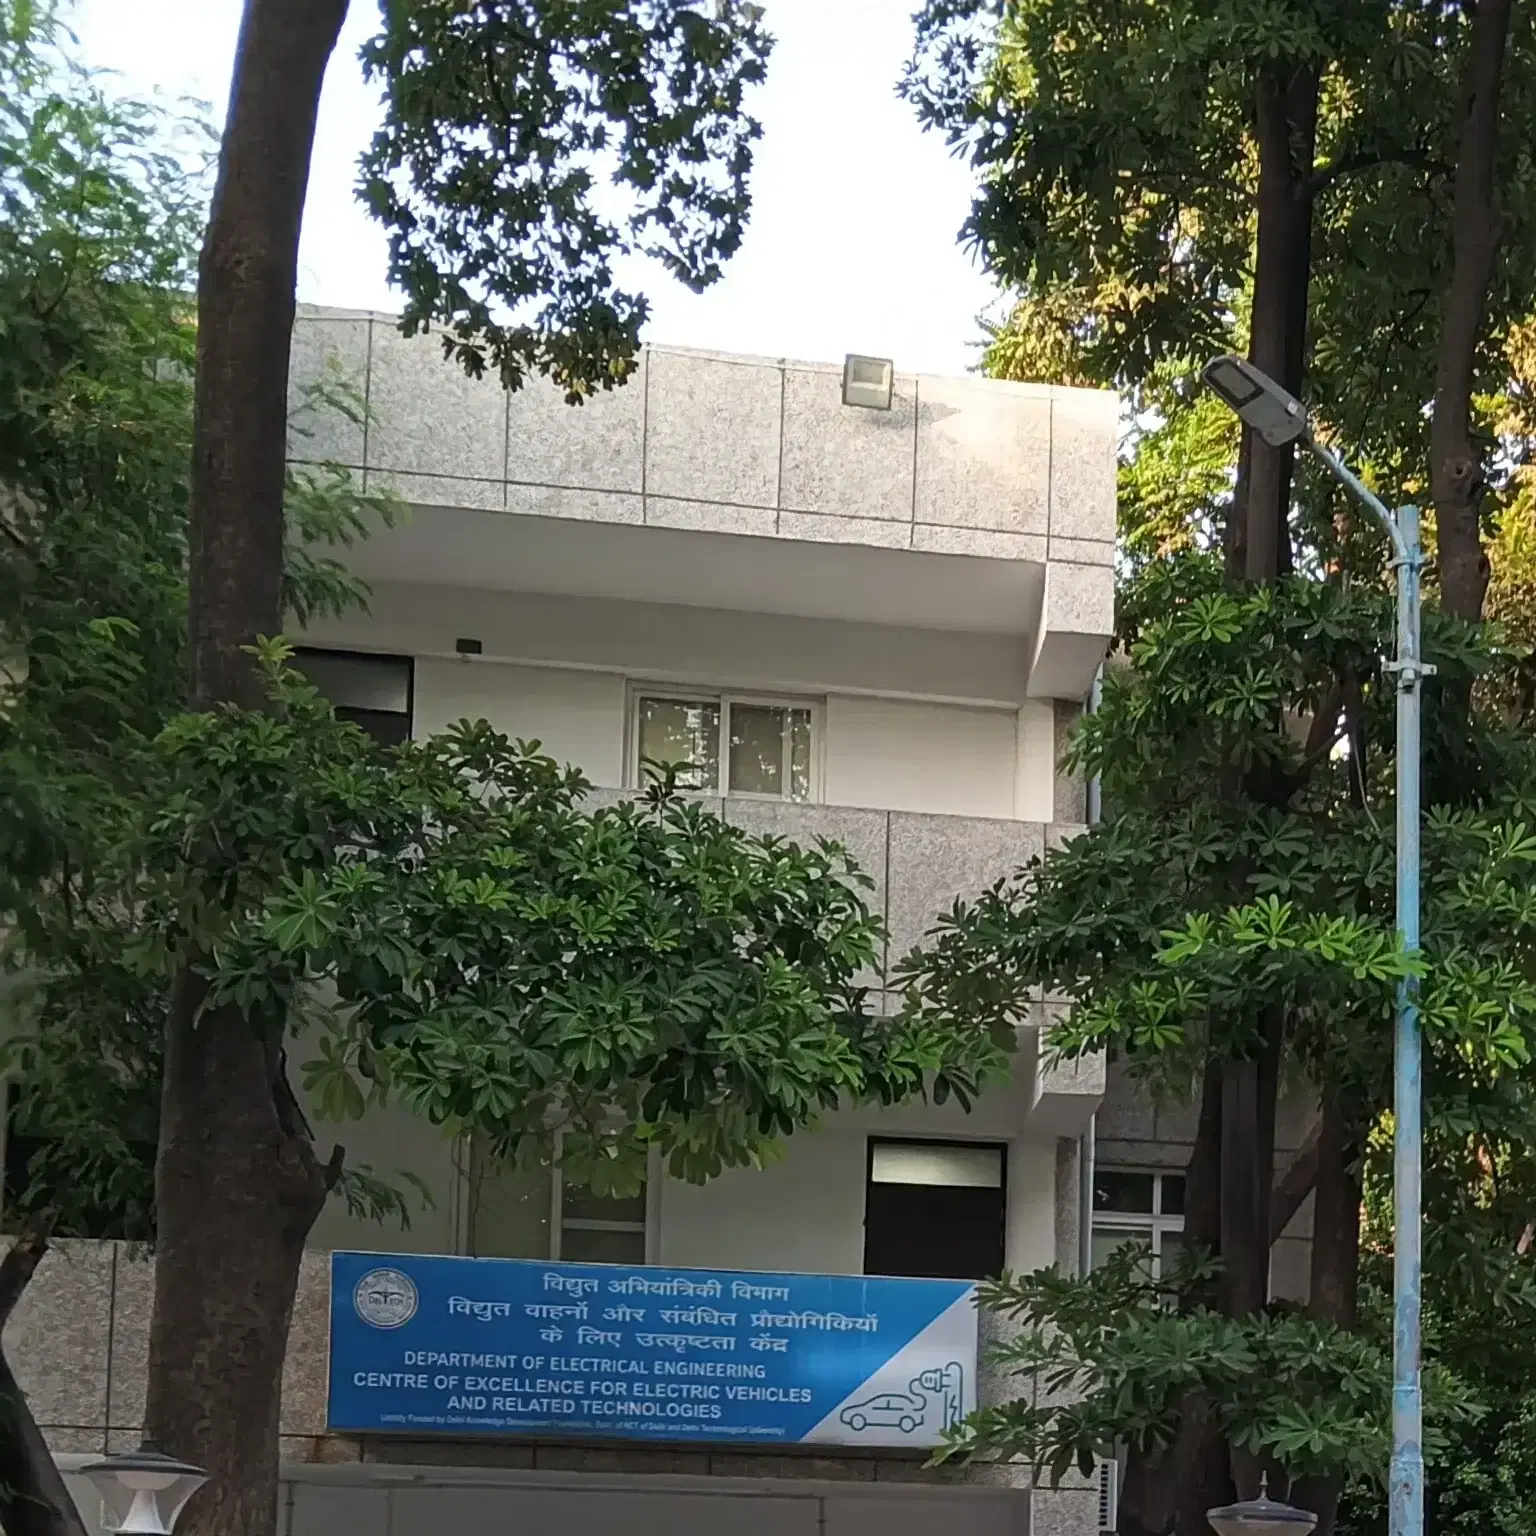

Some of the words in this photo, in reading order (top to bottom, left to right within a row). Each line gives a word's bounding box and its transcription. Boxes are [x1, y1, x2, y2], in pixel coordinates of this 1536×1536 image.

[543, 1272, 599, 1298] विद्युत
[607, 1275, 722, 1299] अभियांत्रिकी
[731, 1280, 790, 1301] विभाग
[447, 1296, 511, 1321] विद्युत
[524, 1301, 589, 1320] वाहनों
[602, 1304, 647, 1322] और
[659, 1305, 737, 1326] संबंधित
[539, 1325, 564, 1343] के
[576, 1326, 622, 1347] लिए
[635, 1333, 736, 1354] उत्कृष्टता
[749, 1333, 789, 1353] केंद्र
[404, 1351, 517, 1370] DEPARTMENT
[522, 1355, 545, 1371] OF
[551, 1356, 648, 1375] ELECTRICAL
[654, 1361, 766, 1379] ENGINEERING
[353, 1371, 429, 1389] CENTRE
[434, 1374, 460, 1390] OF
[465, 1376, 585, 1395] EXCELLENCE
[591, 1381, 627, 1396] FOR
[633, 1383, 719, 1400] ELECTRIC
[725, 1385, 812, 1403] VEHICLES
[447, 1396, 487, 1411] AND
[492, 1397, 575, 1415] RELATED
[581, 1399, 722, 1419] TECHNOLOGIES
